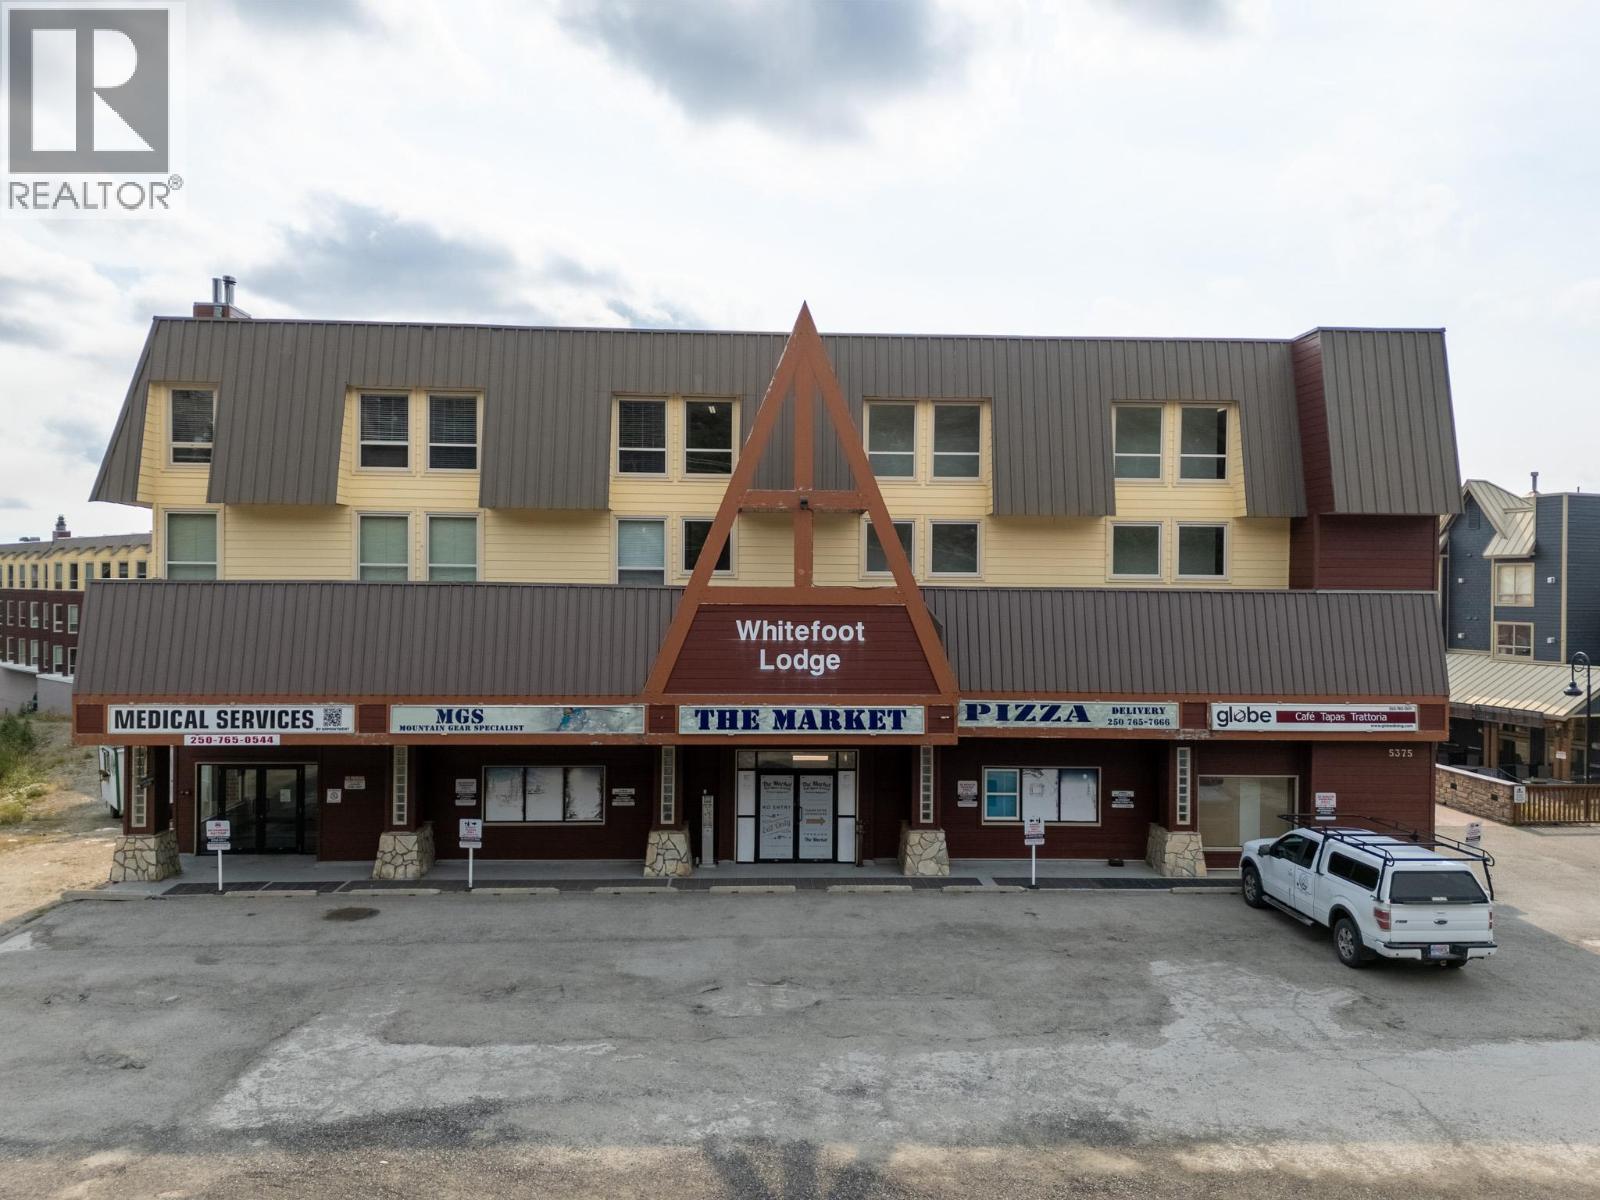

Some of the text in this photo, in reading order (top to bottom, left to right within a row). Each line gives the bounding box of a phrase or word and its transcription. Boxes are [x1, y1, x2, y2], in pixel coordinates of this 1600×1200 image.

[736, 619, 865, 641] Whitefoot
[760, 649, 841, 676] Lodge
[114, 709, 314, 729] MEDICAL SERVICES
[435, 708, 484, 724] MGS
[964, 703, 1091, 722] PIZZA
[1111, 706, 1166, 715] DELIVERY
[1216, 706, 1272, 727] globe
[1295, 711, 1387, 722] Café Tapas Trattoria
[694, 709, 907, 730] THE MARKET
[1107, 718, 1124, 726] 250
[190, 736, 274, 744] 250-765-0544
[1388, 749, 1413, 758] 5375
